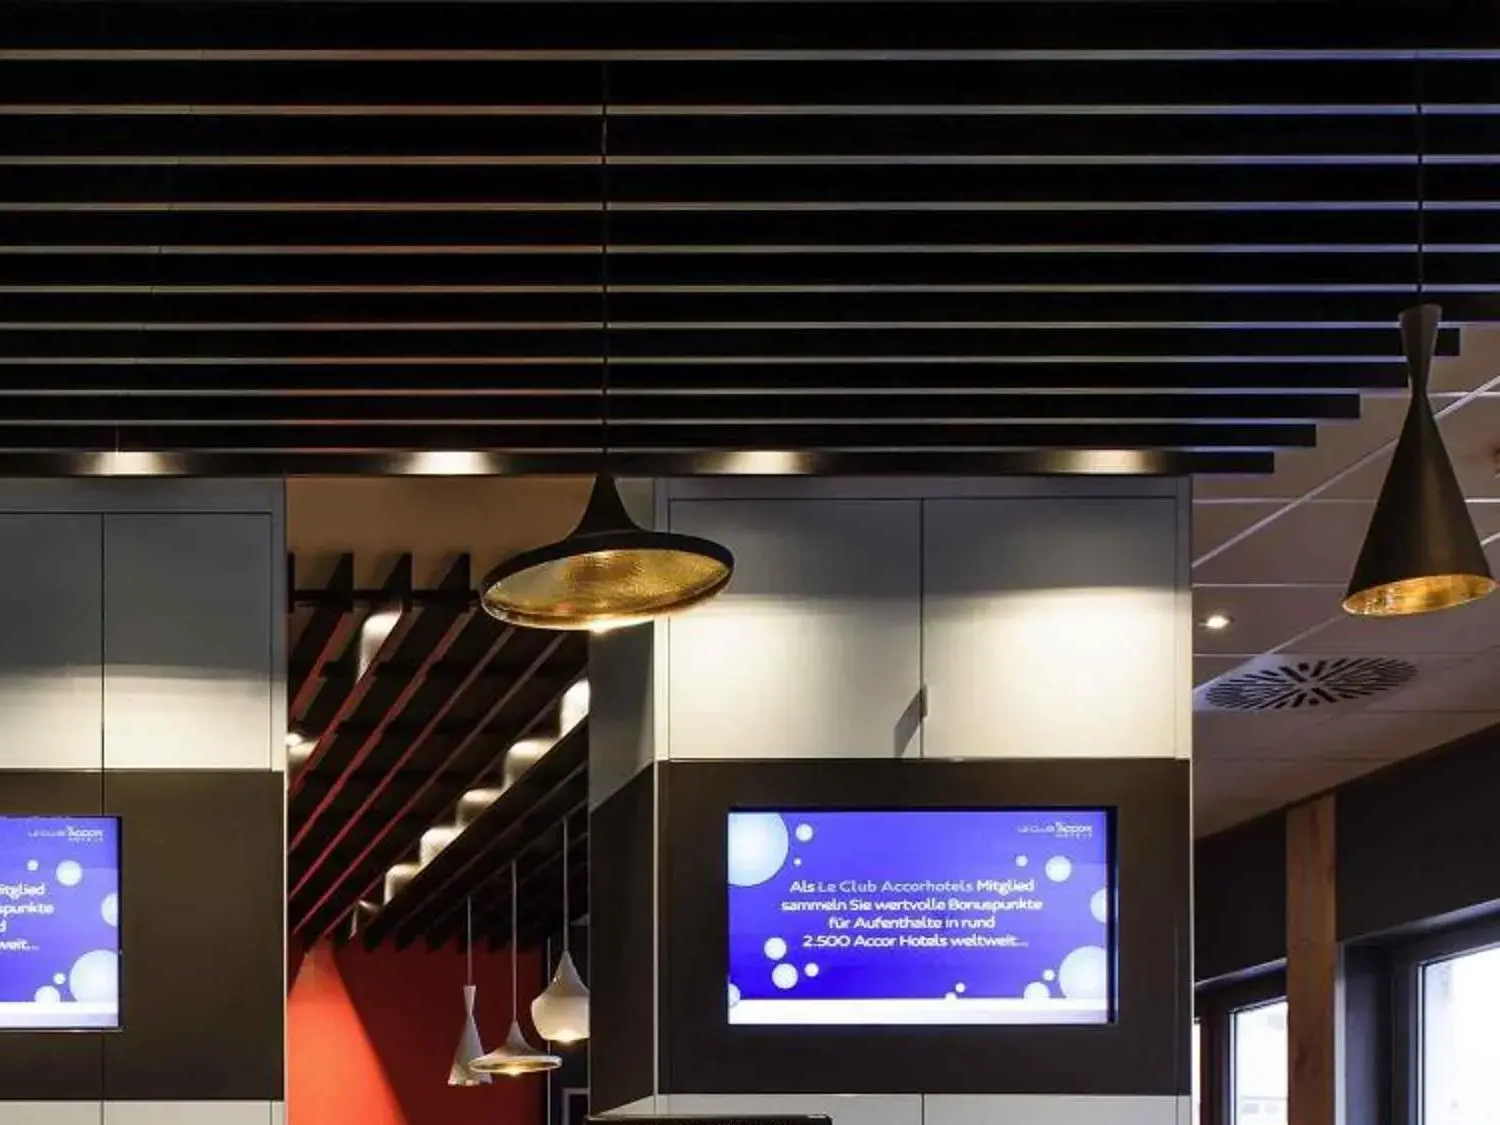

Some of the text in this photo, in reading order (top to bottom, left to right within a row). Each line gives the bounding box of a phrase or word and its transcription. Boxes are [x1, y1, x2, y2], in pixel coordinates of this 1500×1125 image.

[790, 879, 1034, 896] Als Le Club Accorhotels Mitglied
[782, 897, 1043, 915] sammeln Sie wertvolle Bonuspunkte
[829, 916, 995, 929] für Aufenthalte in rund
[803, 935, 850, 947] 2.500
[854, 935, 896, 947] Accor
[900, 935, 948, 947] Hotels
